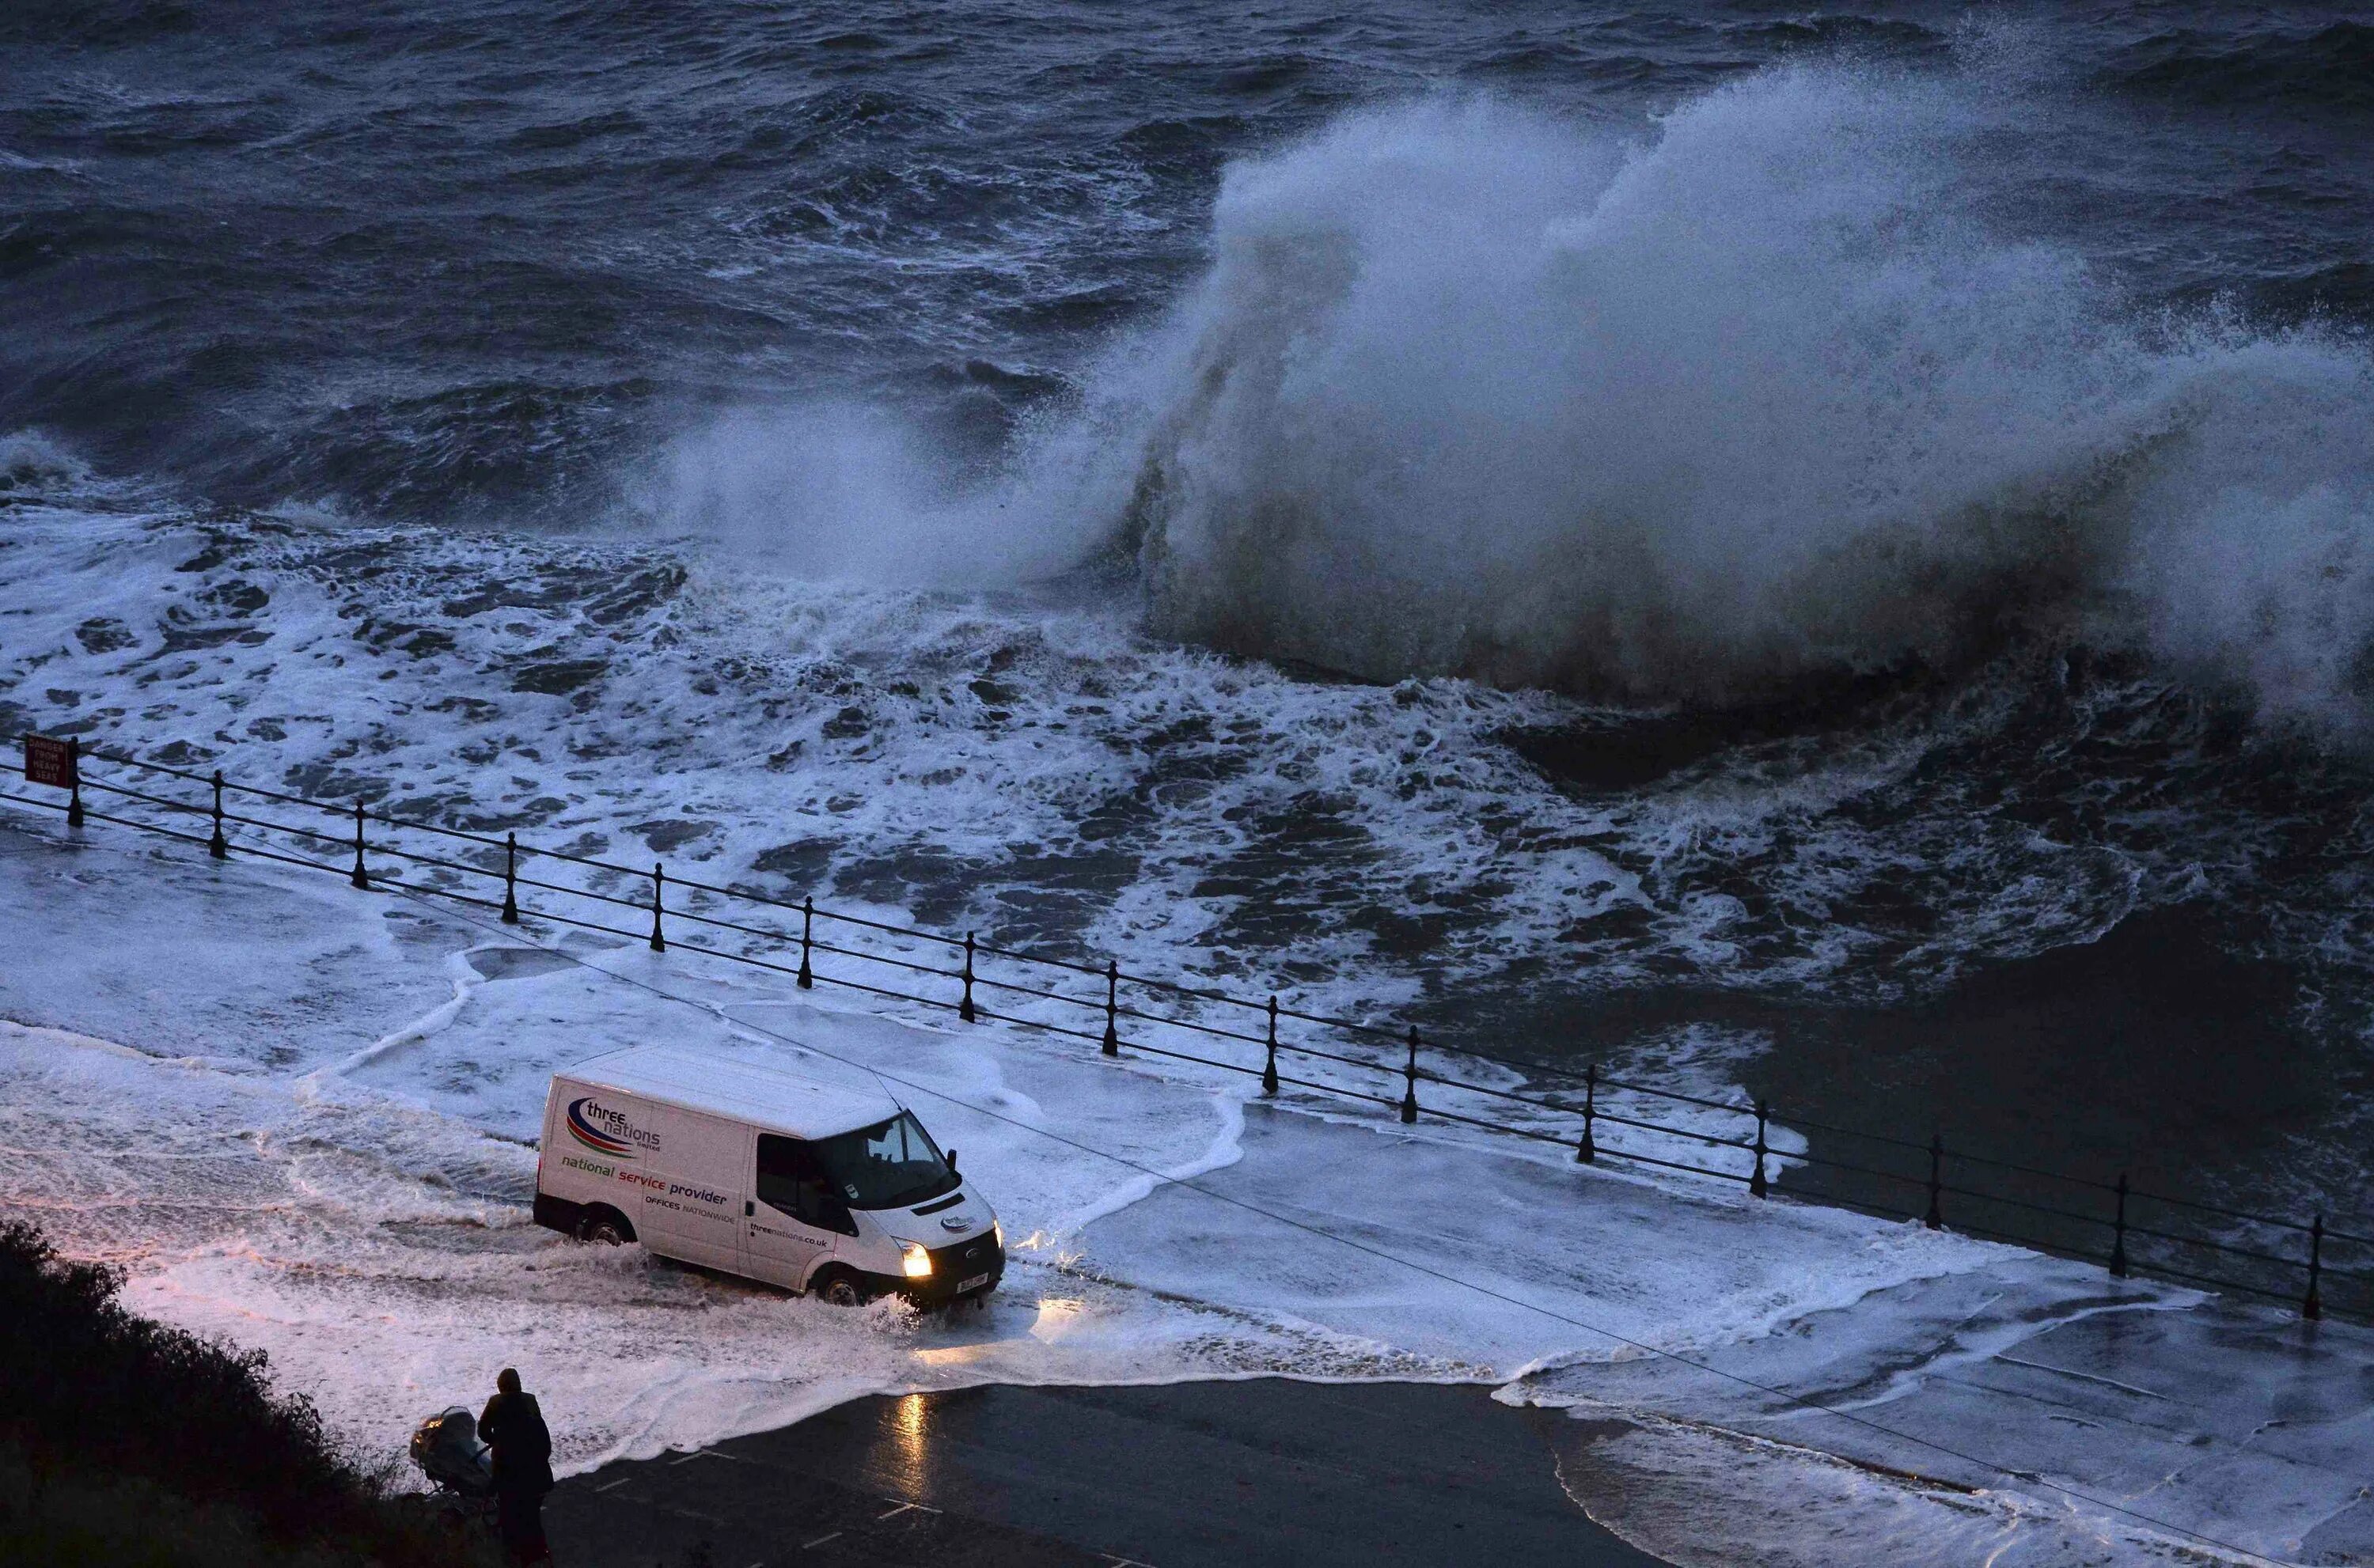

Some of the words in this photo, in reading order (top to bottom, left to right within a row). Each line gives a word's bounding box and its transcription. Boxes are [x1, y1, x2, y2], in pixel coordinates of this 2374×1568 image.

[29, 737, 64, 753] DANGER
[35, 748, 59, 762] FROM
[33, 759, 61, 773] HEAVY
[36, 770, 58, 782] SEAS
[587, 1101, 626, 1125] three
[604, 1121, 661, 1145] nations
[637, 1142, 661, 1152] limited
[562, 1156, 615, 1178] national
[619, 1171, 666, 1191] service
[669, 1183, 727, 1205] provider
[645, 1195, 681, 1210] OFFICES
[682, 1204, 735, 1225] NATIONWIDE
[750, 1223, 828, 1248] threenations.co.uk
